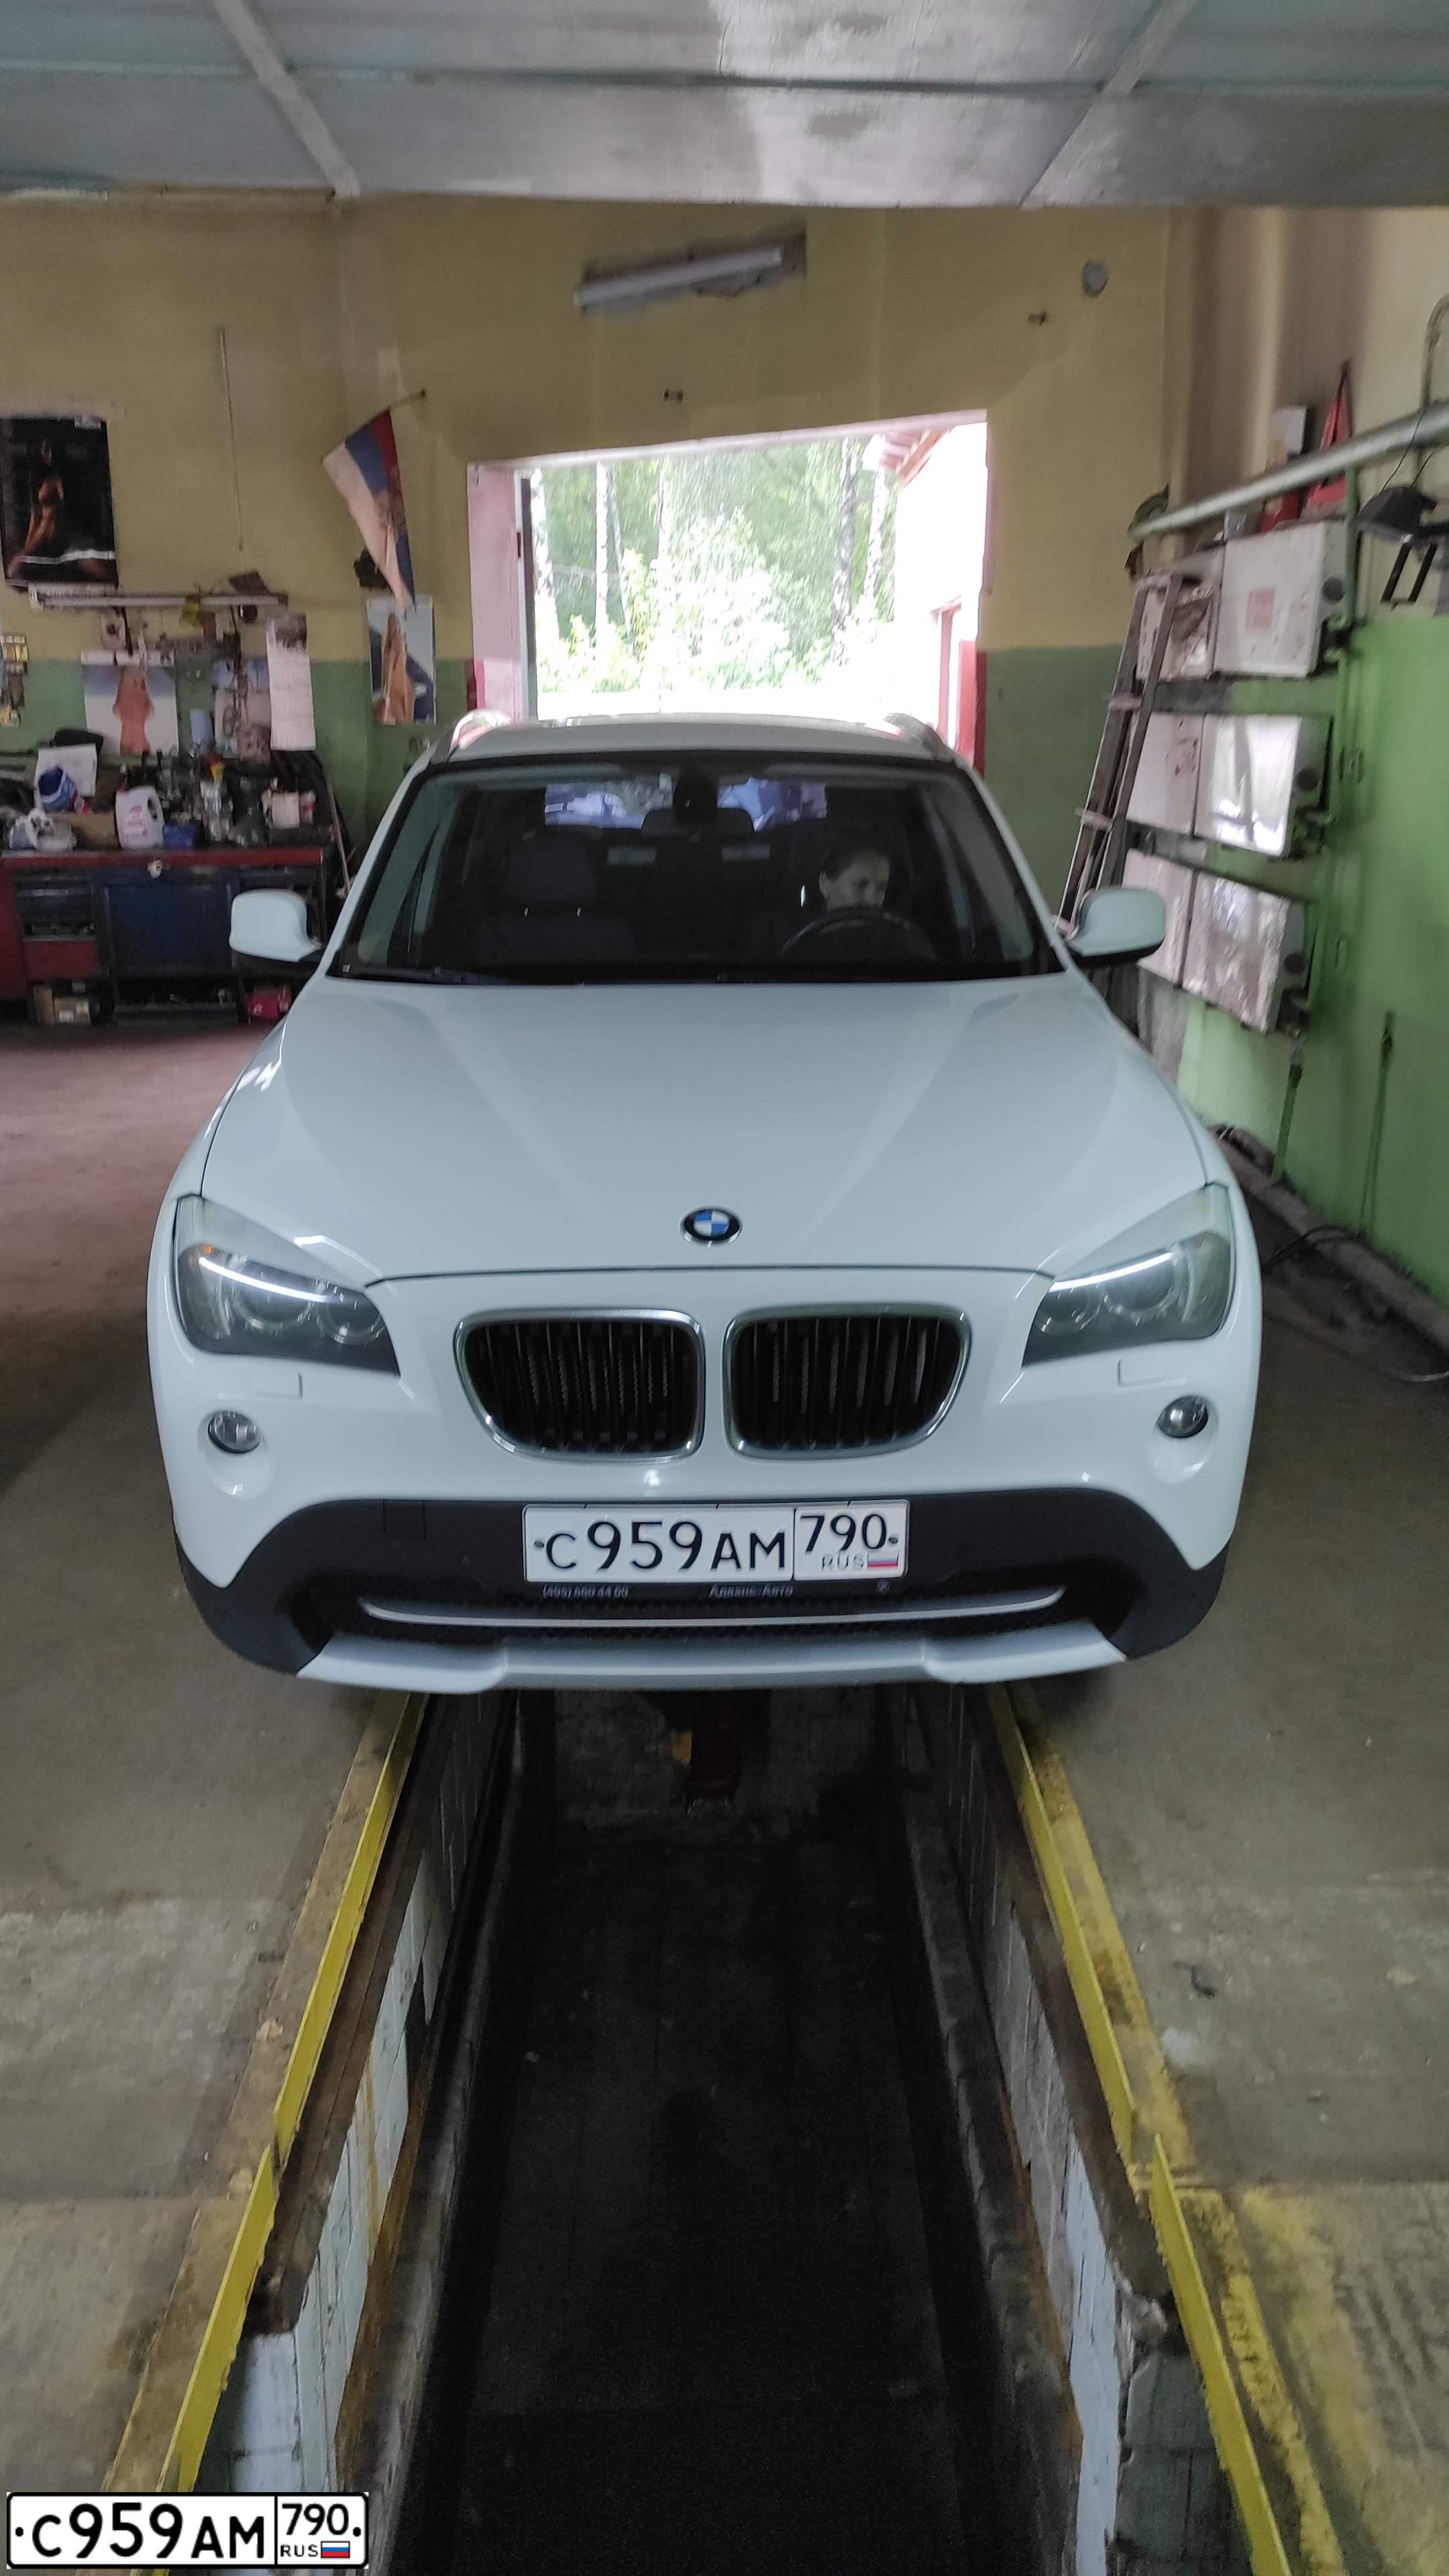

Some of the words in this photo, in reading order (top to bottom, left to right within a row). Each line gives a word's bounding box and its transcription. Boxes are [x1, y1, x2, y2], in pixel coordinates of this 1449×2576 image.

[545, 1520, 786, 1571] С959АМ
[800, 1513, 888, 1552] 790
[821, 1554, 865, 1570] RUS
